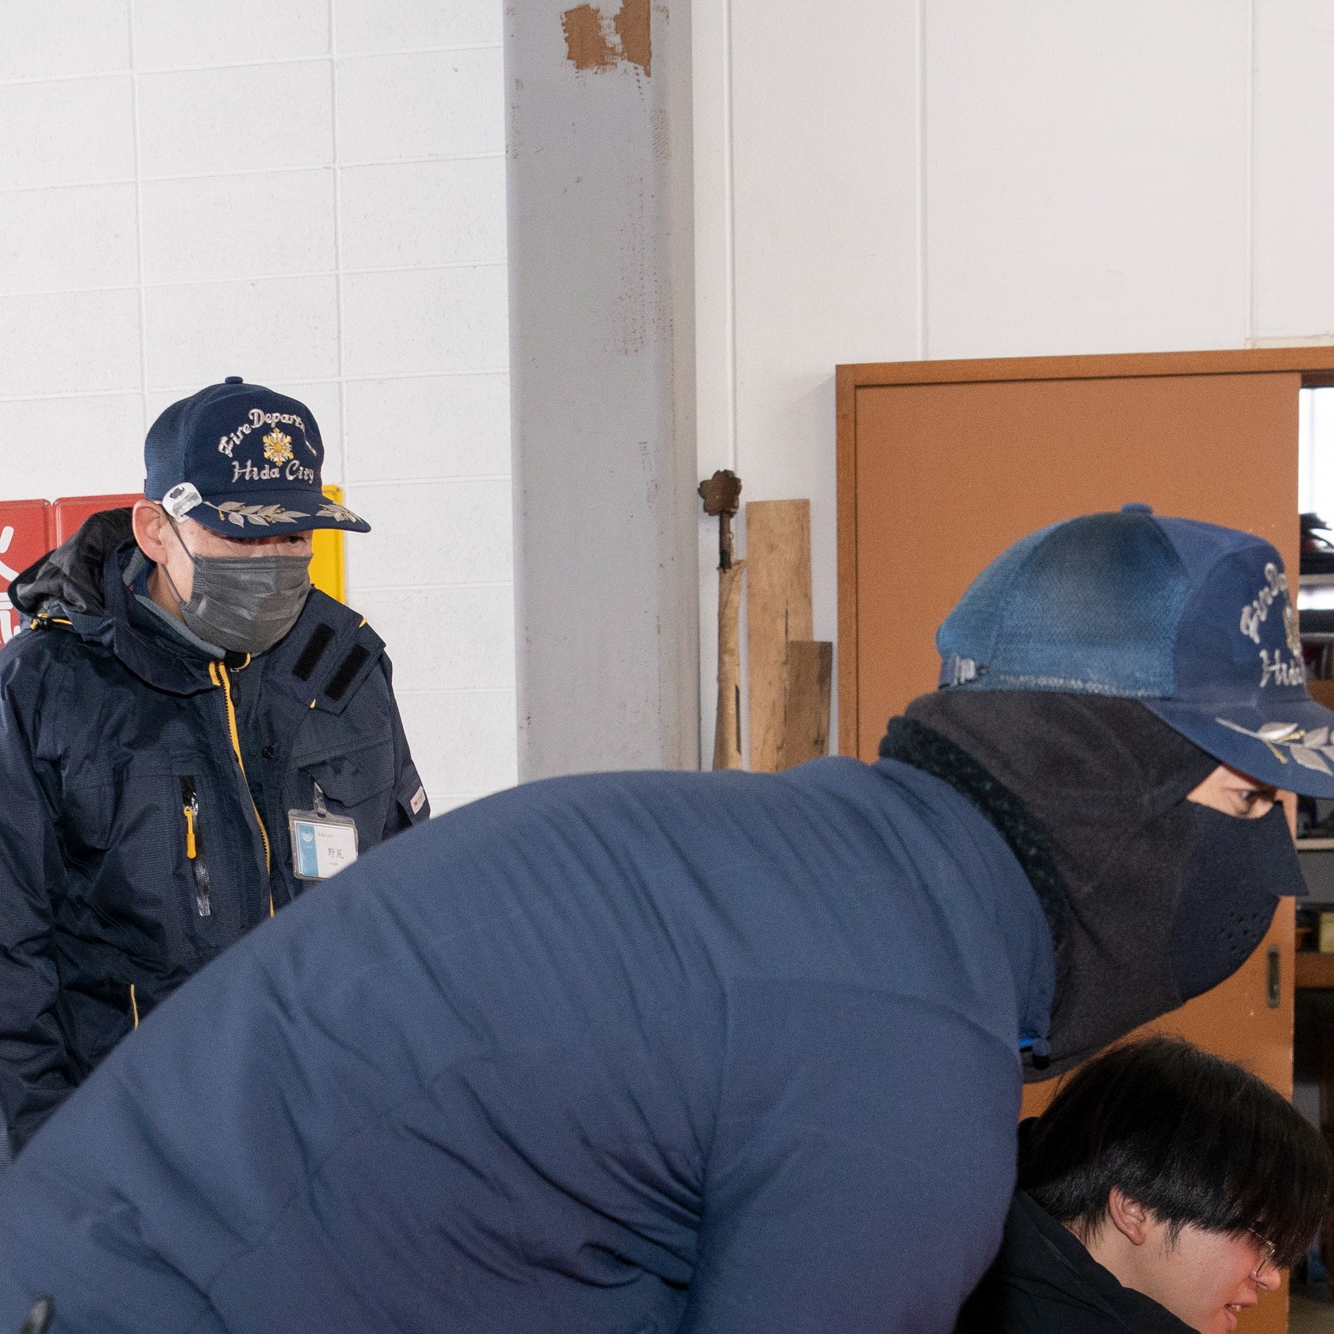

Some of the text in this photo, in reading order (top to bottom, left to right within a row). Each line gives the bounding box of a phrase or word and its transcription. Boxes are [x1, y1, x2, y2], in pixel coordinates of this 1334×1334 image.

[218, 408, 317, 458] Fire Depart
[231, 459, 280, 483] Hida
